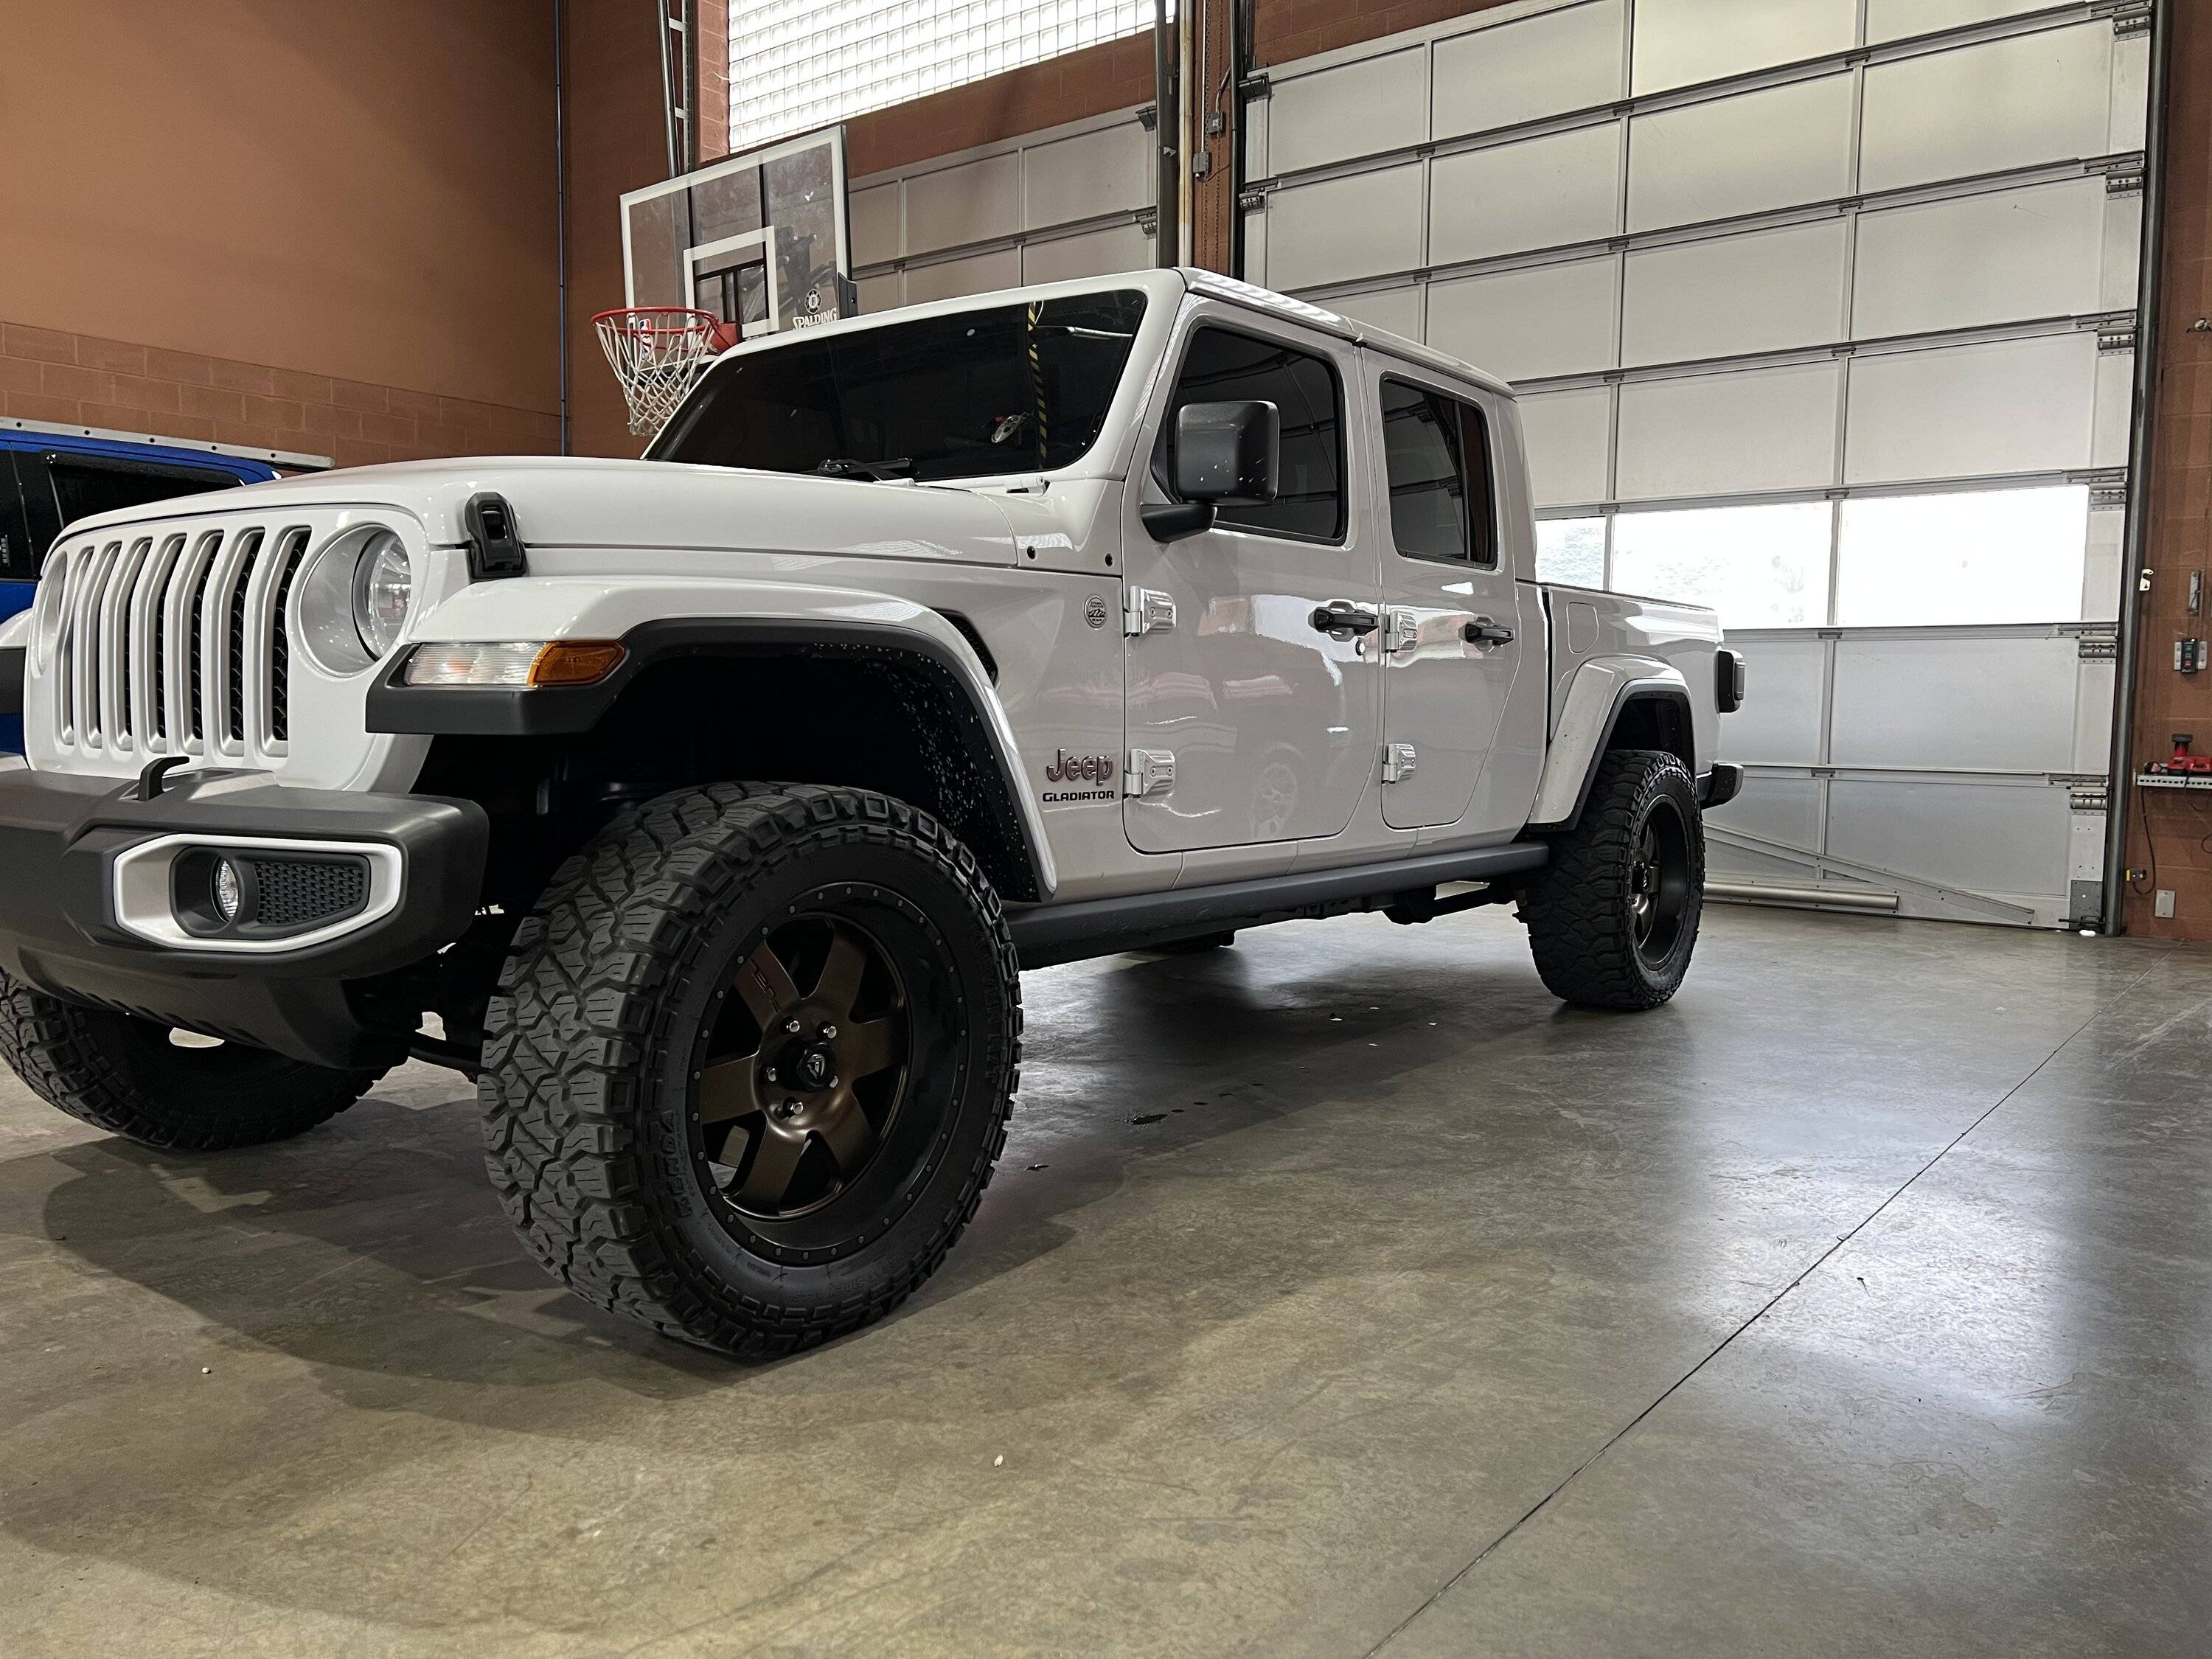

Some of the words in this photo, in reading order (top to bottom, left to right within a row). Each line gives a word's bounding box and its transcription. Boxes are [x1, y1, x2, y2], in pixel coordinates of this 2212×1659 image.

[792, 307, 838, 331] SPALDING
[1046, 748, 1113, 786] Jeep
[1042, 790, 1115, 802] GLADIATOR
[660, 1109, 693, 1217] KENDA
